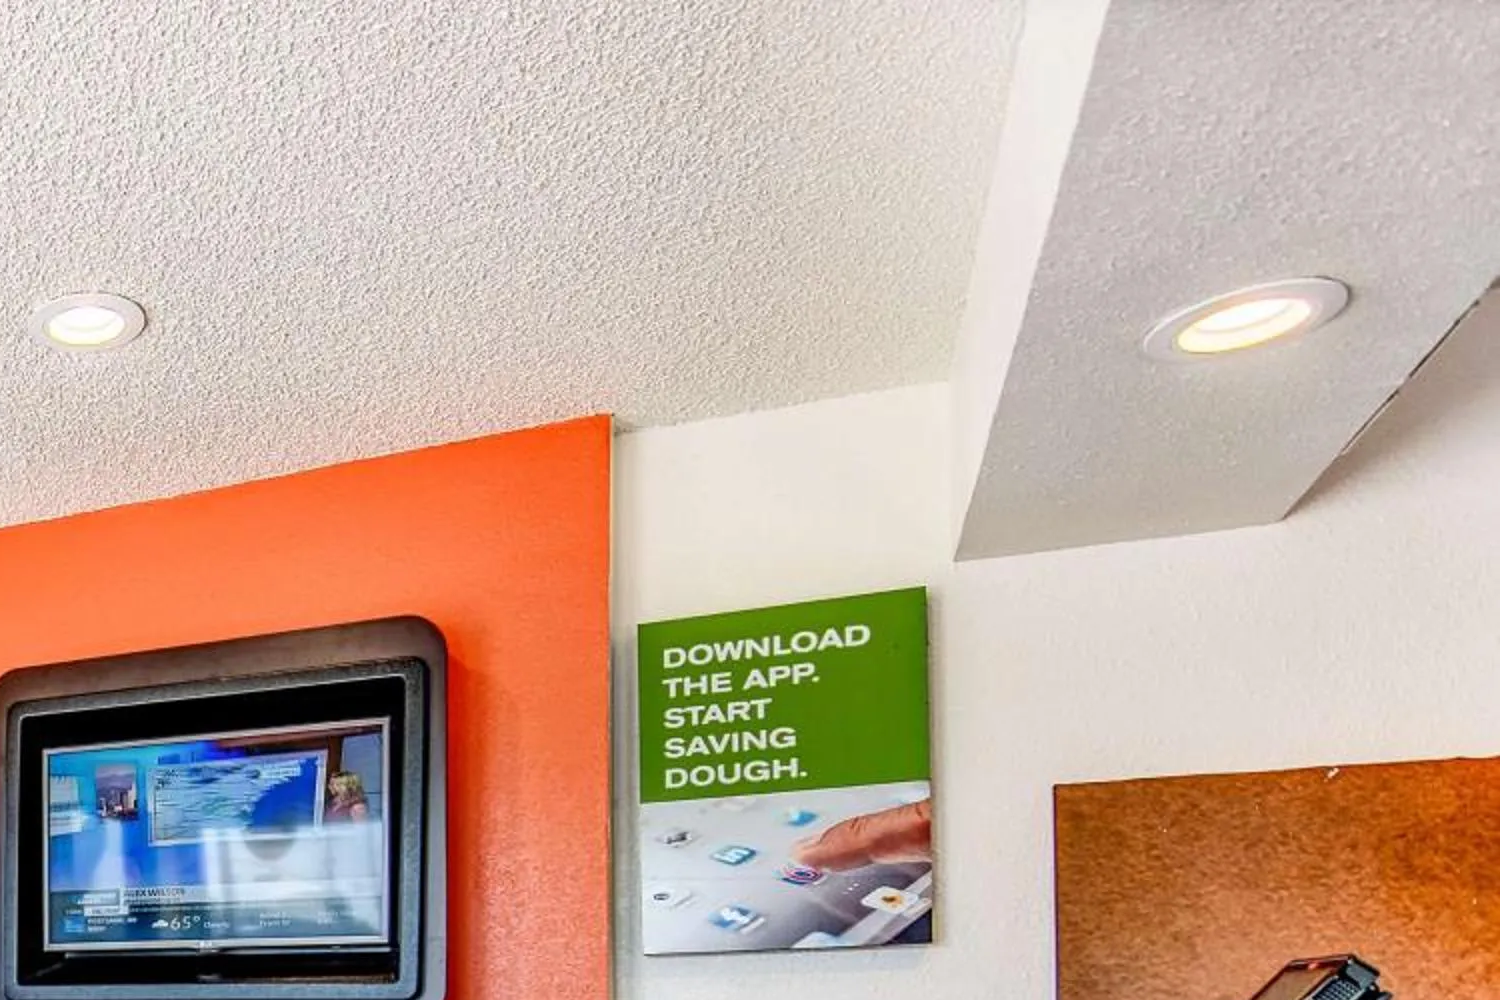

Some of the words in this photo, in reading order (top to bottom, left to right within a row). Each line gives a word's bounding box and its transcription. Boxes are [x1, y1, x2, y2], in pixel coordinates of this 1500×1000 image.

[663, 624, 870, 669] DOWNLOAD
[662, 672, 732, 698] THE
[742, 662, 820, 690] APP.
[664, 698, 773, 728] START
[664, 727, 797, 759] SAVING
[665, 758, 808, 789] DOUGH.
